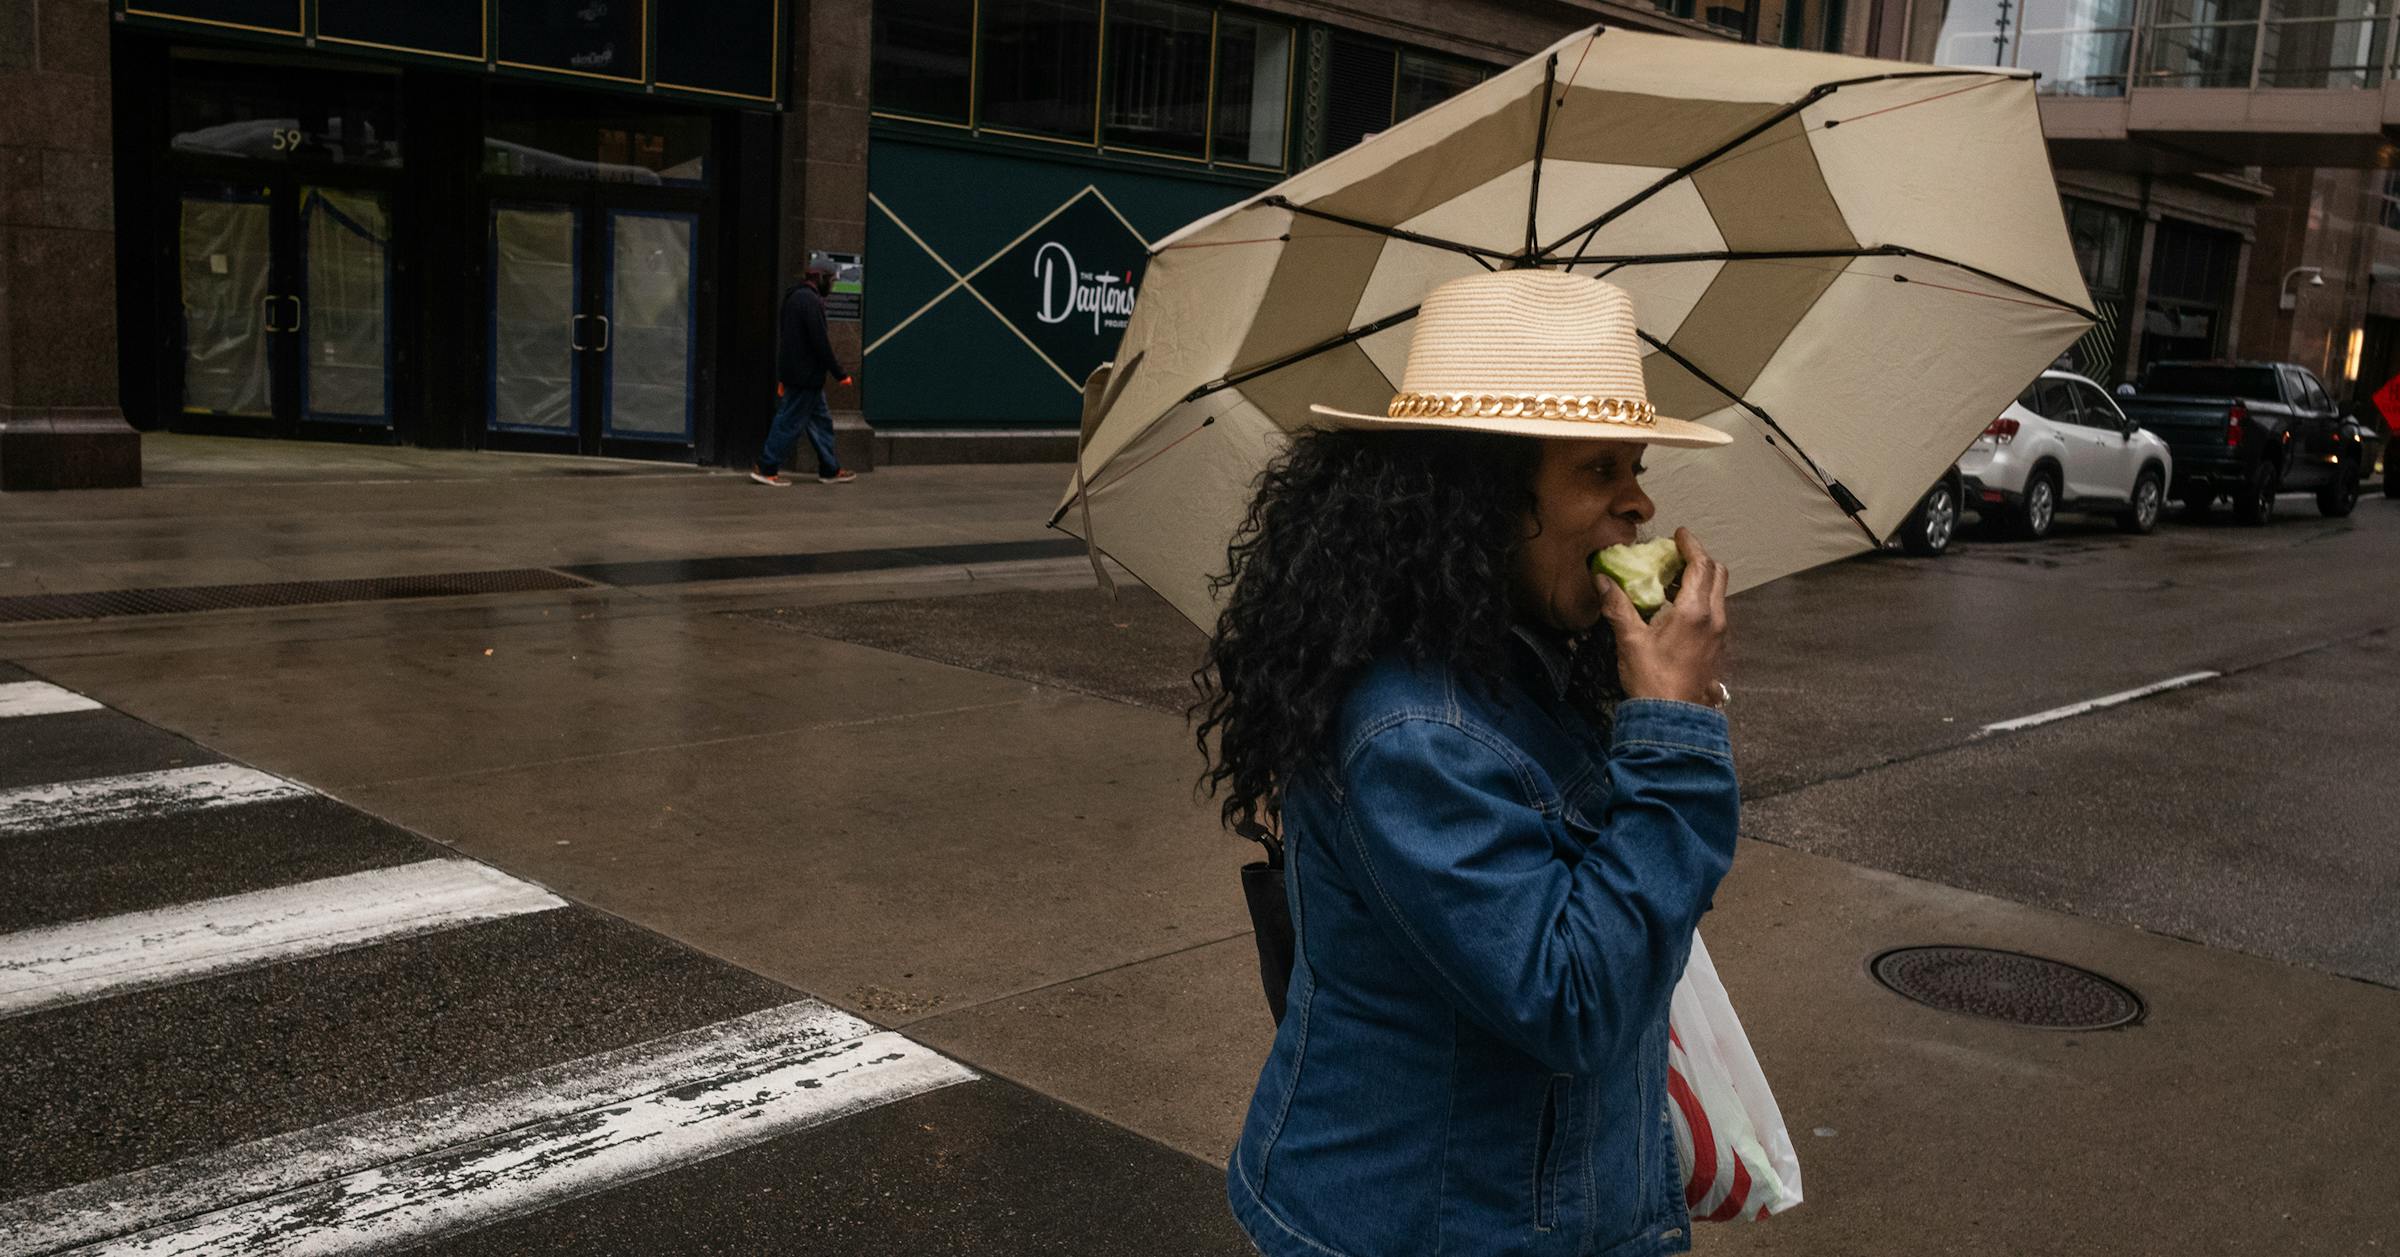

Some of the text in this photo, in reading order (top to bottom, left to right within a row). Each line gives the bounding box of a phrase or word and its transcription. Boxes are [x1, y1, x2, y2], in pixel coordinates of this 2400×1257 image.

[272, 128, 301, 152] 59
[1080, 272, 1094, 281] THE
[1034, 241, 1135, 336] Dayton's
[1104, 319, 1129, 328] PROJEC
